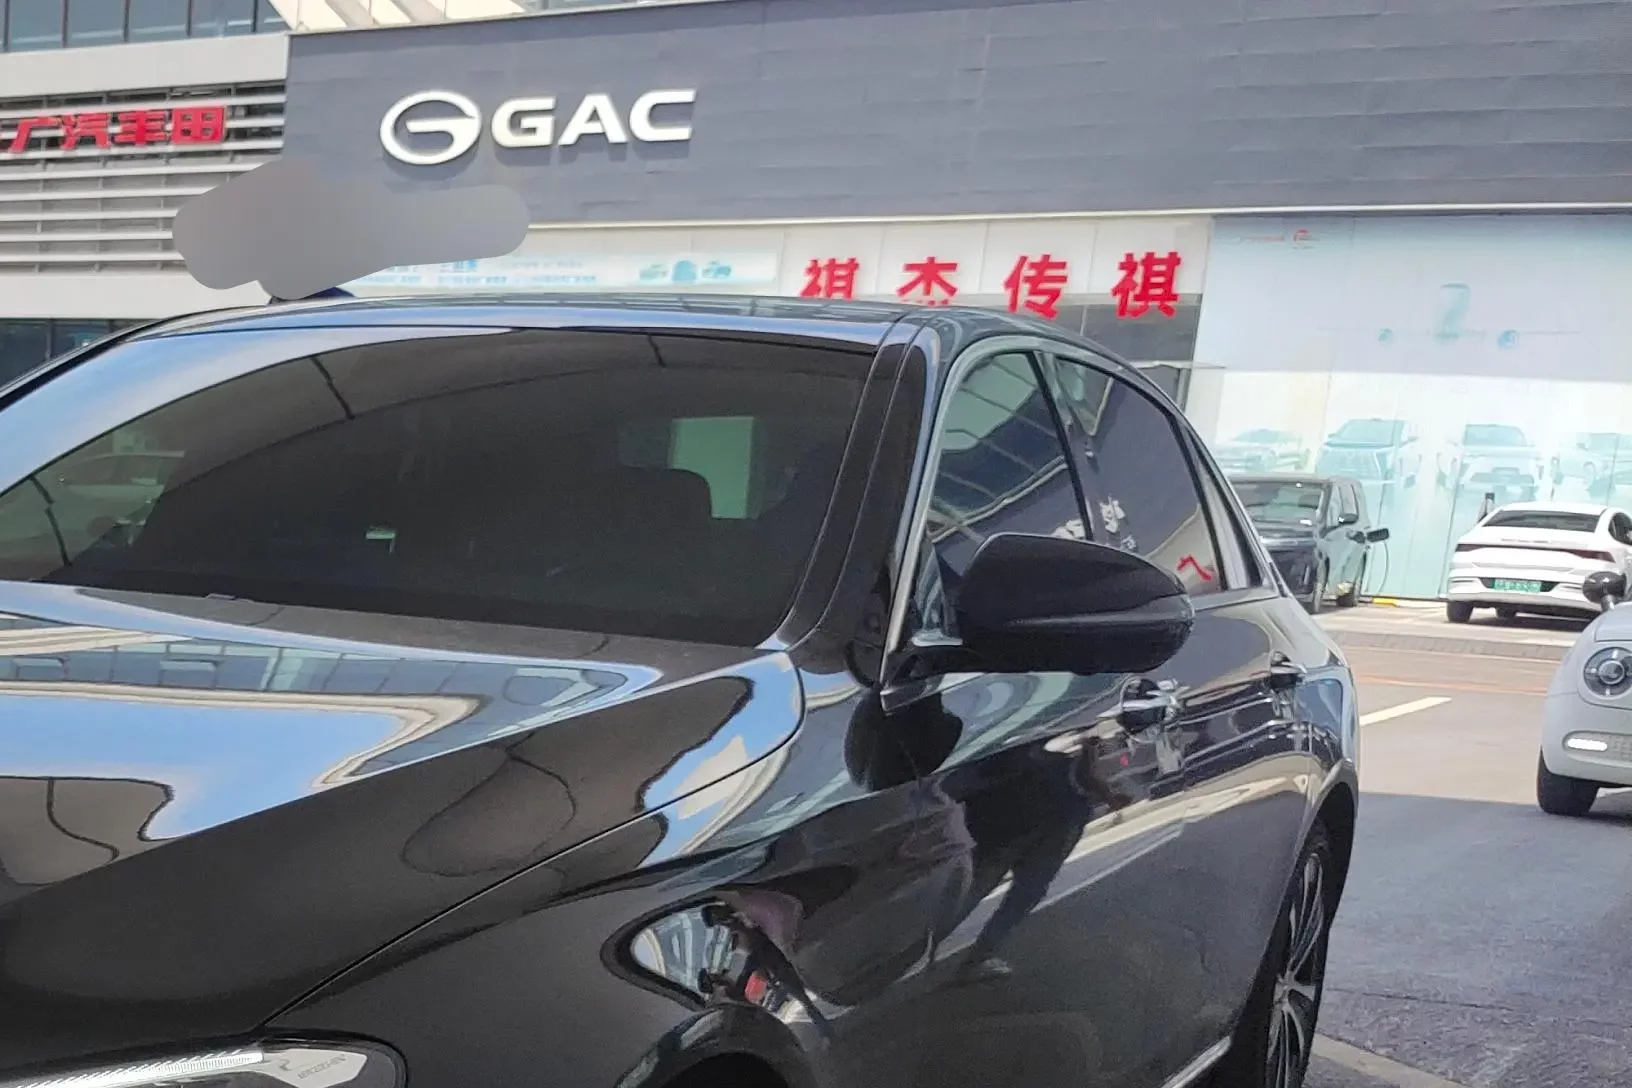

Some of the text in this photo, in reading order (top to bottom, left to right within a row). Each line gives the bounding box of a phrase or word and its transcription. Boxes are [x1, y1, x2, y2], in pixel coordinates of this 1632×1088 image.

[9, 105, 228, 153] 广汽丰田
[491, 88, 697, 149] GAC
[799, 250, 1183, 319] 祺杰传祺
